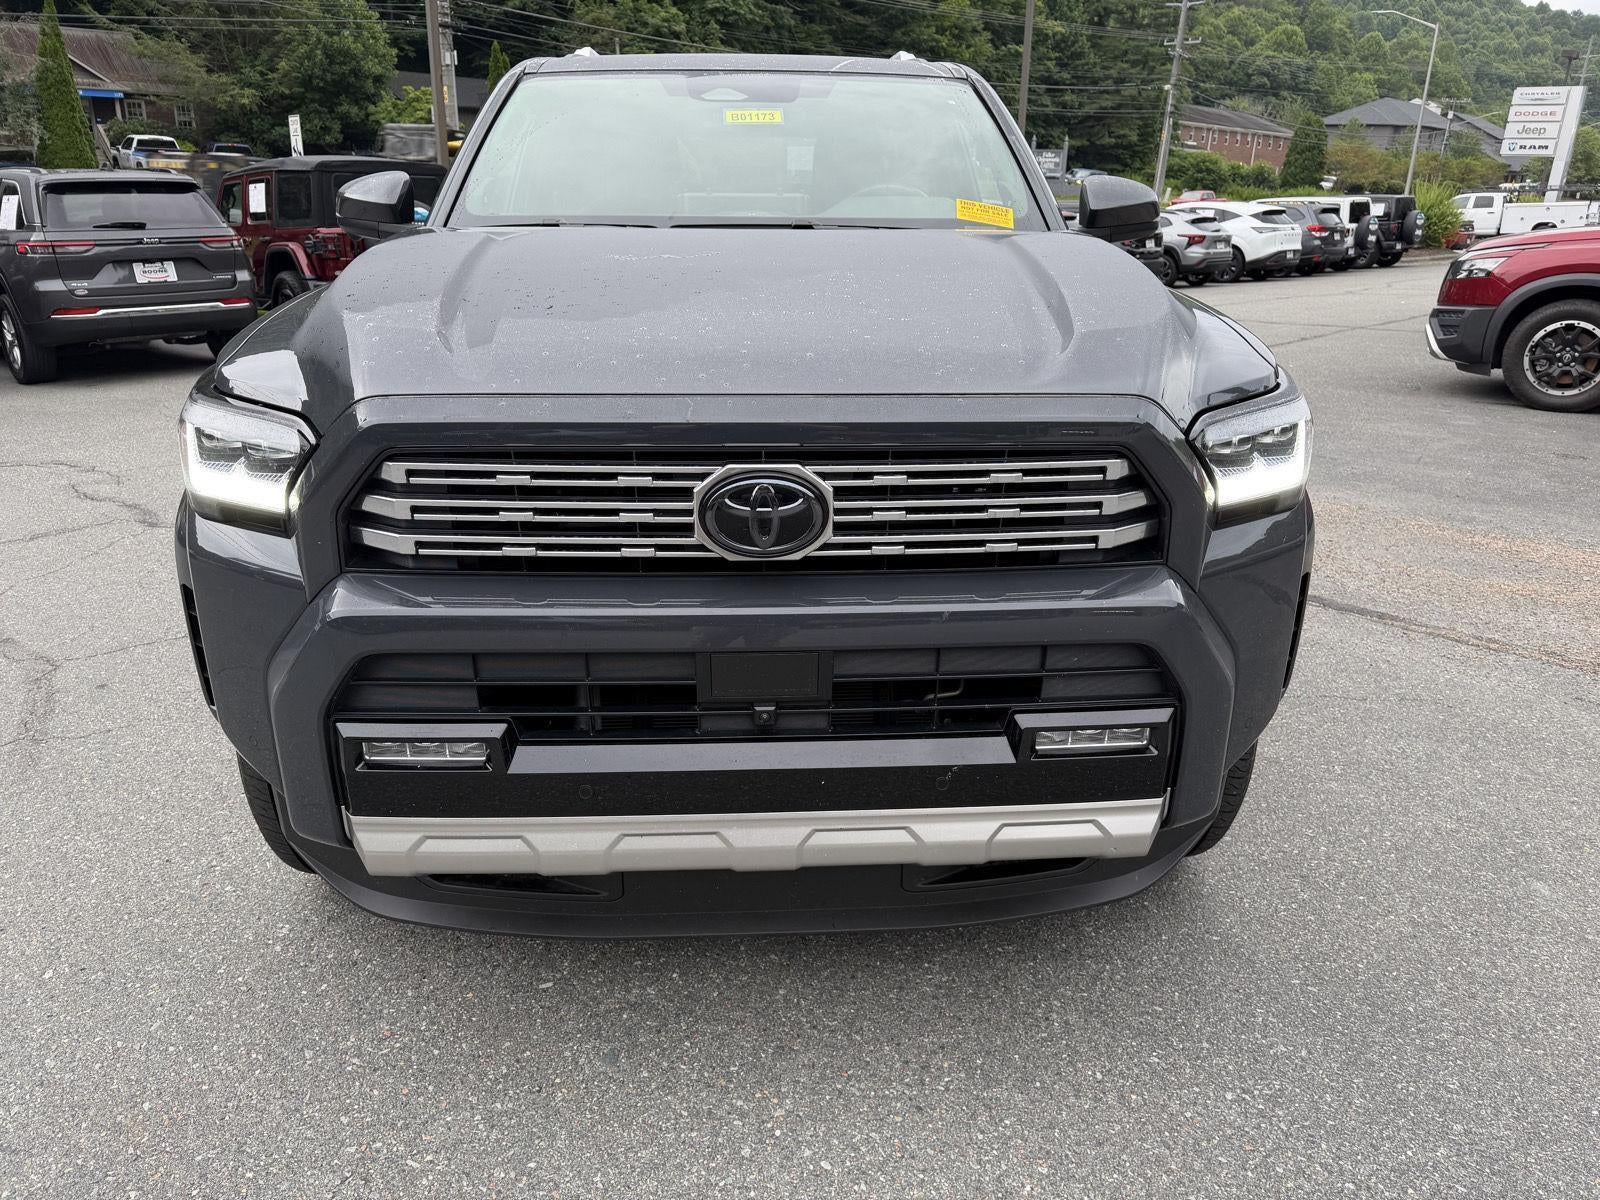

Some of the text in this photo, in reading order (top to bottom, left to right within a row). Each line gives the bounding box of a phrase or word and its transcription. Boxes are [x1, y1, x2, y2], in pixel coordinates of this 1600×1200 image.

[731, 111, 775, 121] B01173
[1517, 125, 1546, 136] Jeep
[978, 203, 1009, 214] VEHICLE
[143, 237, 159, 245] Jeep
